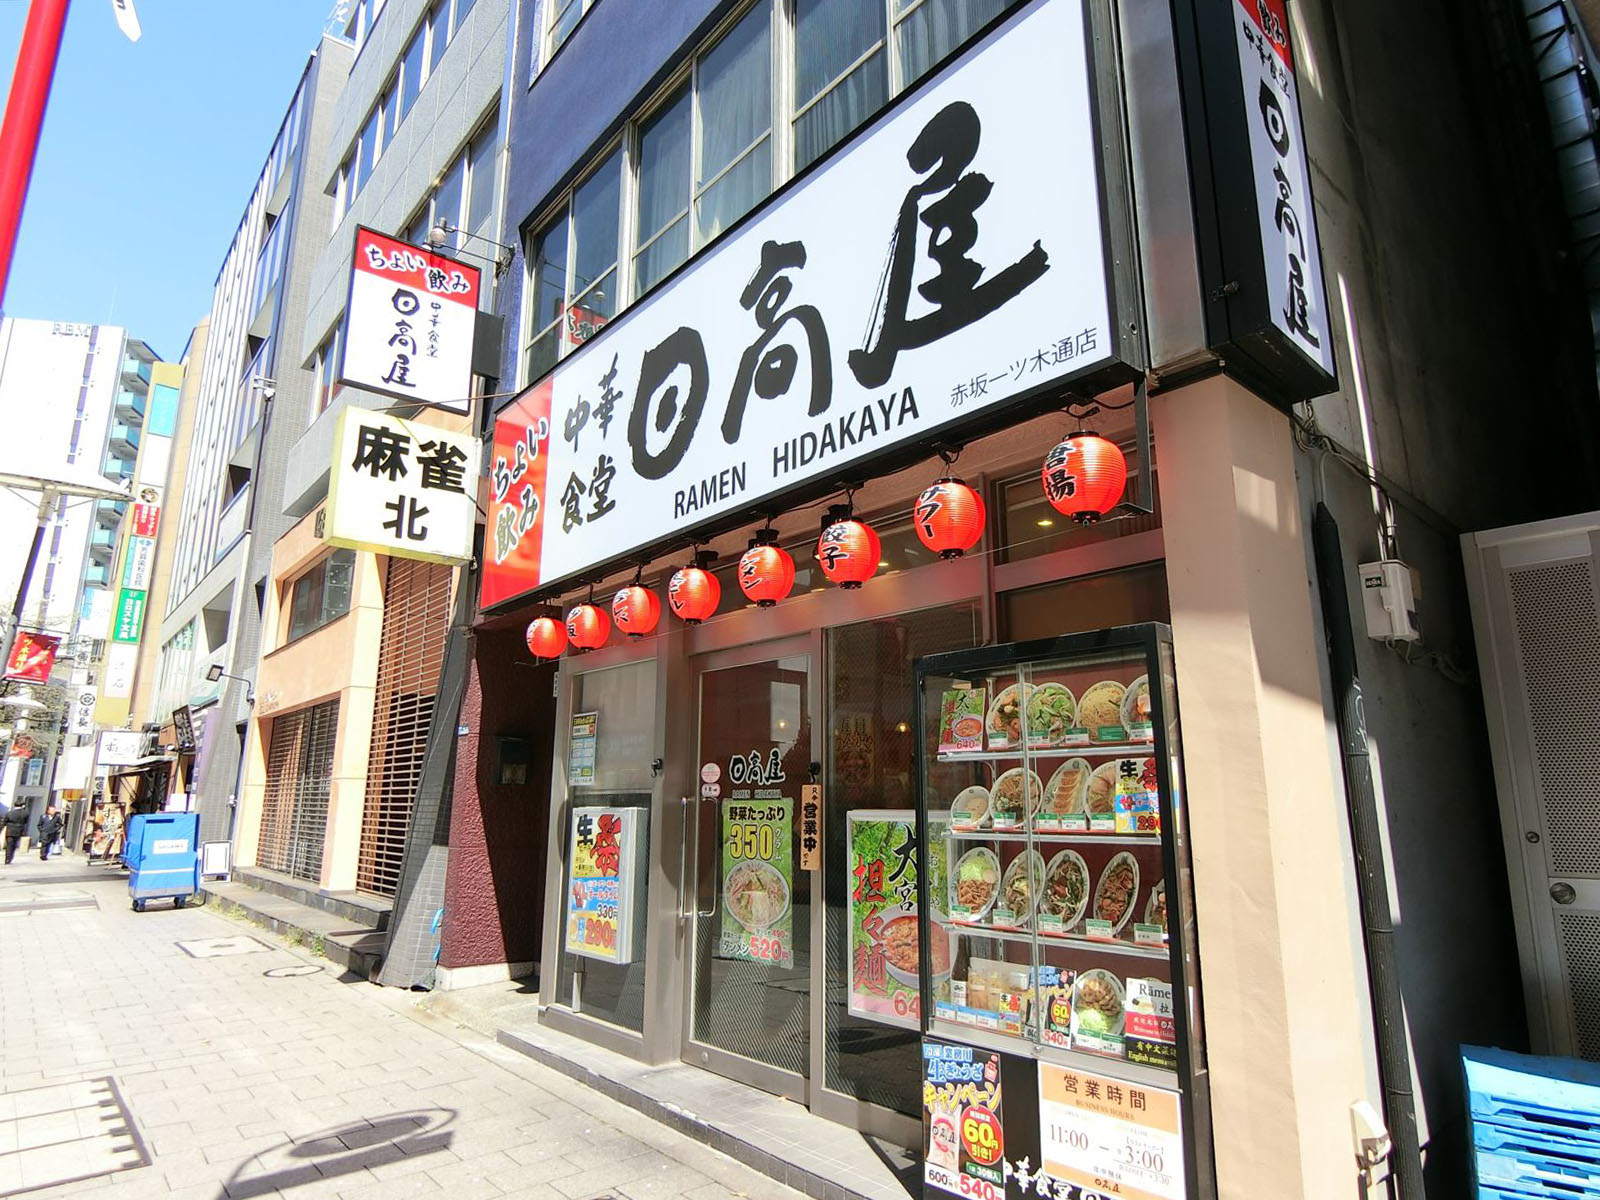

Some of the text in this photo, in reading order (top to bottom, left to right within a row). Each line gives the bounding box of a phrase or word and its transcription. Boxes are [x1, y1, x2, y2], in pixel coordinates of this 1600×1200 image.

[1259, 77, 1320, 349] 日高屋
[627, 100, 1051, 480] 日高屋
[382, 287, 421, 388] 日高屋
[950, 327, 1098, 408] 赤坂一ツ木通店
[563, 352, 623, 453] 中華
[352, 424, 469, 494] 麻雀
[673, 386, 920, 520] RAMEN HIDAKAYA
[560, 454, 617, 533] 食堂
[383, 495, 430, 542] 北
[731, 749, 785, 784] 日高屋
[1120, 760, 1138, 779] 生
[577, 814, 593, 847] 生
[729, 805, 785, 821] 野菜たっぷり
[803, 802, 818, 853] 営業中
[729, 823, 774, 861] 350
[923, 1080, 1001, 1114] キャンペーン
[1063, 1073, 1147, 1112] 営業時間
[1049, 1123, 1089, 1151] 11:00
[1125, 1145, 1164, 1173] 3:00
